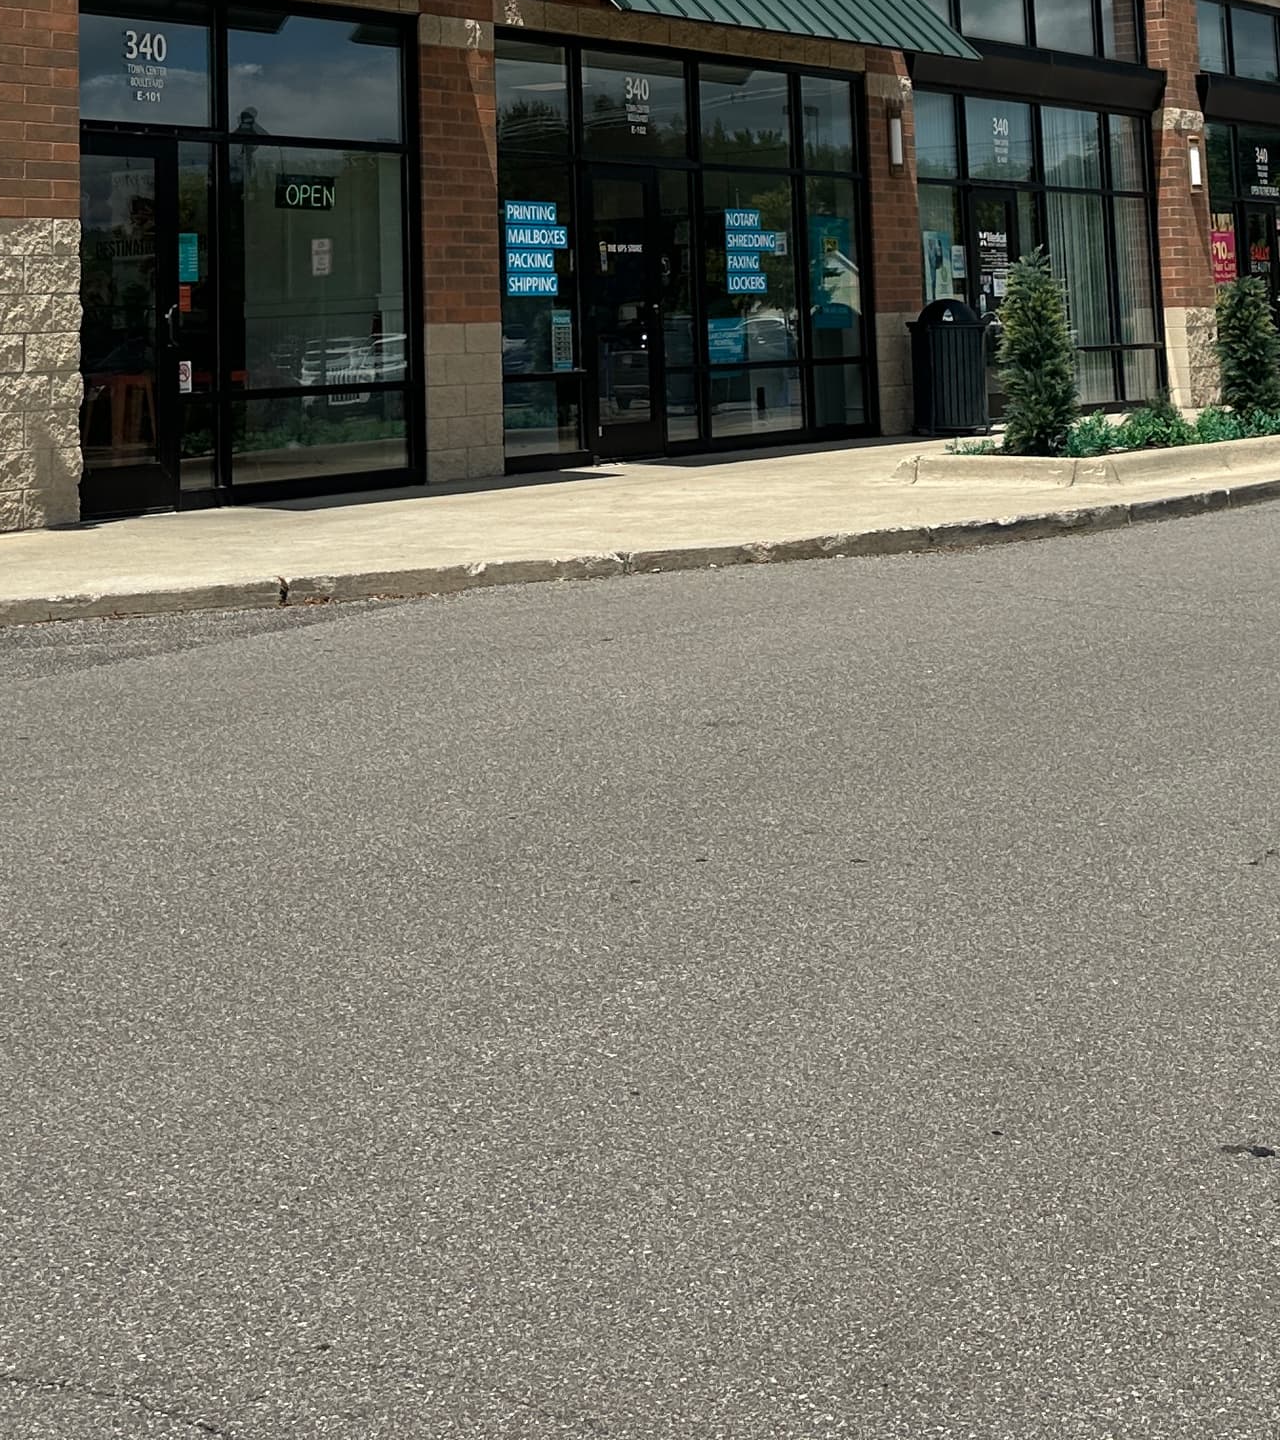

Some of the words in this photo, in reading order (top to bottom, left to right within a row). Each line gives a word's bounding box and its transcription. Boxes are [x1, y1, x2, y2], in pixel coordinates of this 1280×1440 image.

[126, 30, 167, 62] 340
[137, 91, 161, 102] E-101
[625, 76, 649, 101] 340
[992, 117, 1009, 136] 340
[1255, 147, 1268, 164] 340
[286, 184, 335, 207] OPEN
[507, 205, 556, 221] PRINTING
[726, 212, 760, 227] NOTARY
[508, 229, 566, 245] MAILBOXES
[727, 234, 775, 248] SHREDDING
[1212, 241, 1227, 260] $10
[508, 253, 553, 268] PACKING
[728, 256, 759, 269] FAXING
[509, 276, 557, 292] SHIPPING
[729, 276, 766, 290] LOCKERS
